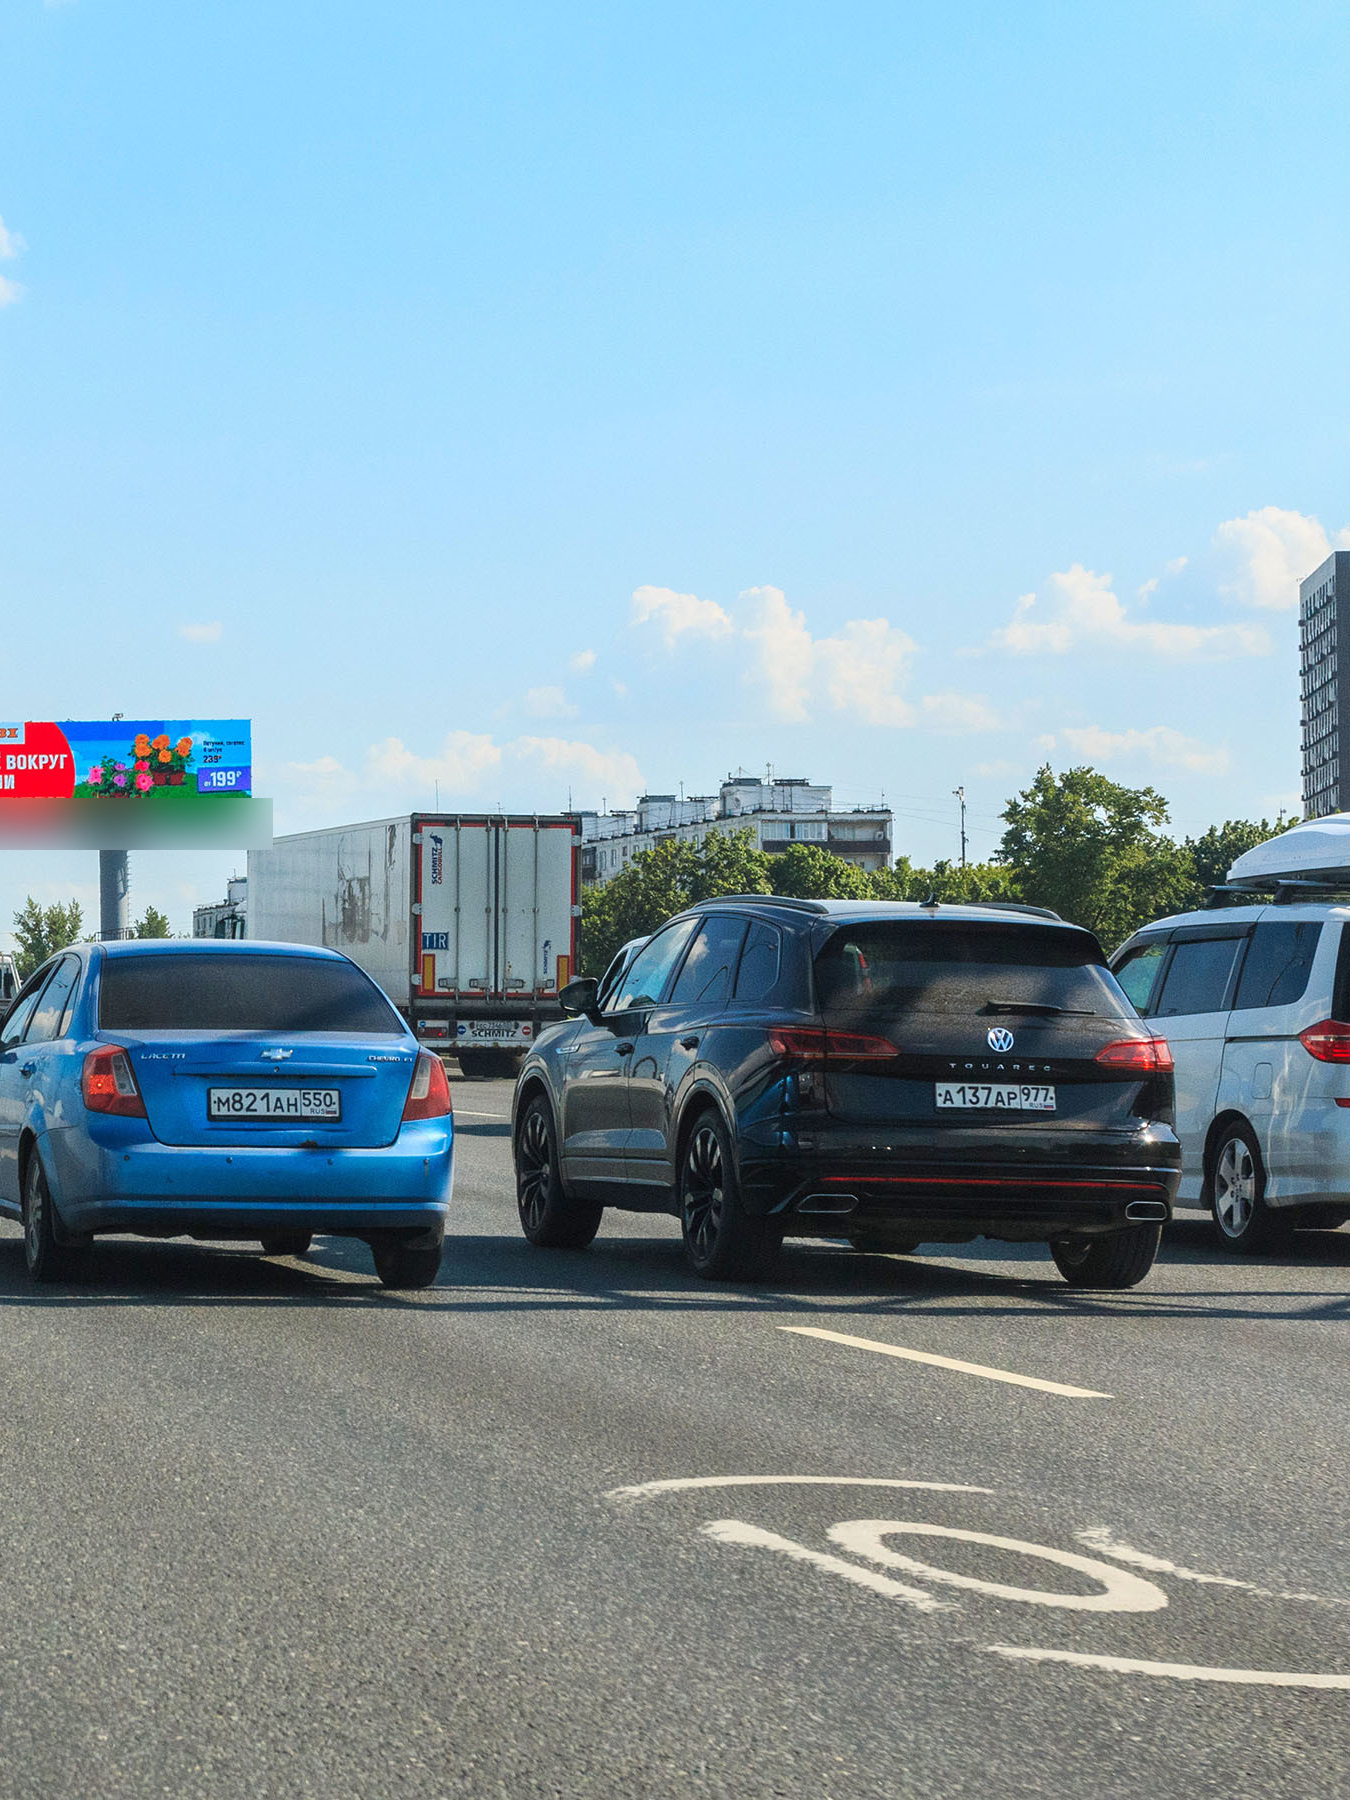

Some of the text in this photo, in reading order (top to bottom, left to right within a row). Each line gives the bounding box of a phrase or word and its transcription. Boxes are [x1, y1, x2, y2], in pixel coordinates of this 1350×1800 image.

[6, 754, 68, 770] ВОКРУГ
[424, 933, 447, 949] TIR
[471, 1029, 517, 1038] SCHMITZ
[216, 1092, 333, 1113] М821АН 550
[943, 1086, 1050, 1107] А137АР 977
